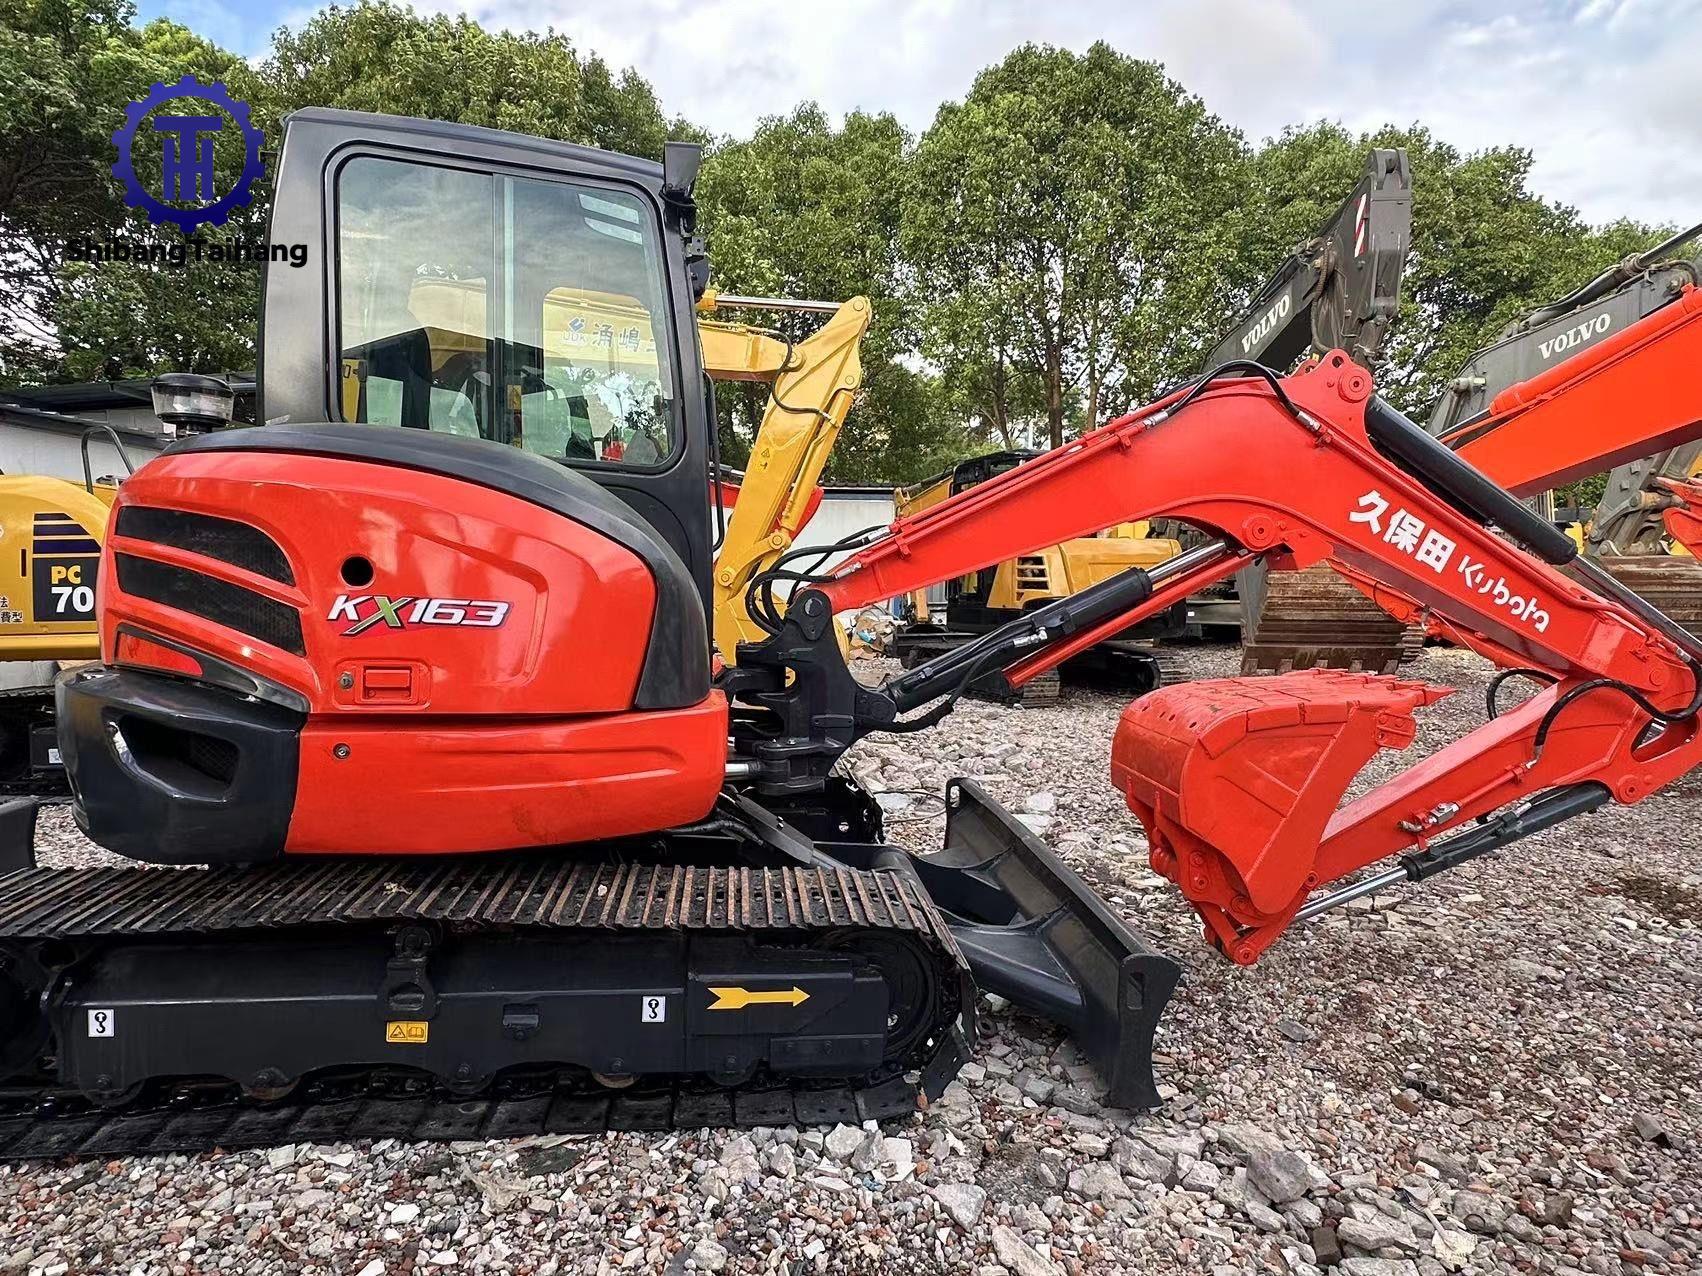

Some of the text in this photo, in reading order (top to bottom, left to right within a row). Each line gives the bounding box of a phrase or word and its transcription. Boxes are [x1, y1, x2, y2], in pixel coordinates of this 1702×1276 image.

[1241, 294, 1290, 353] VOLVO
[1538, 313, 1611, 360] VOLVO
[1349, 489, 1456, 574] 久保田
[51, 564, 81, 585] PC
[1457, 555, 1550, 633] Kubota
[51, 585, 94, 613] 70
[327, 594, 510, 636] KX163
